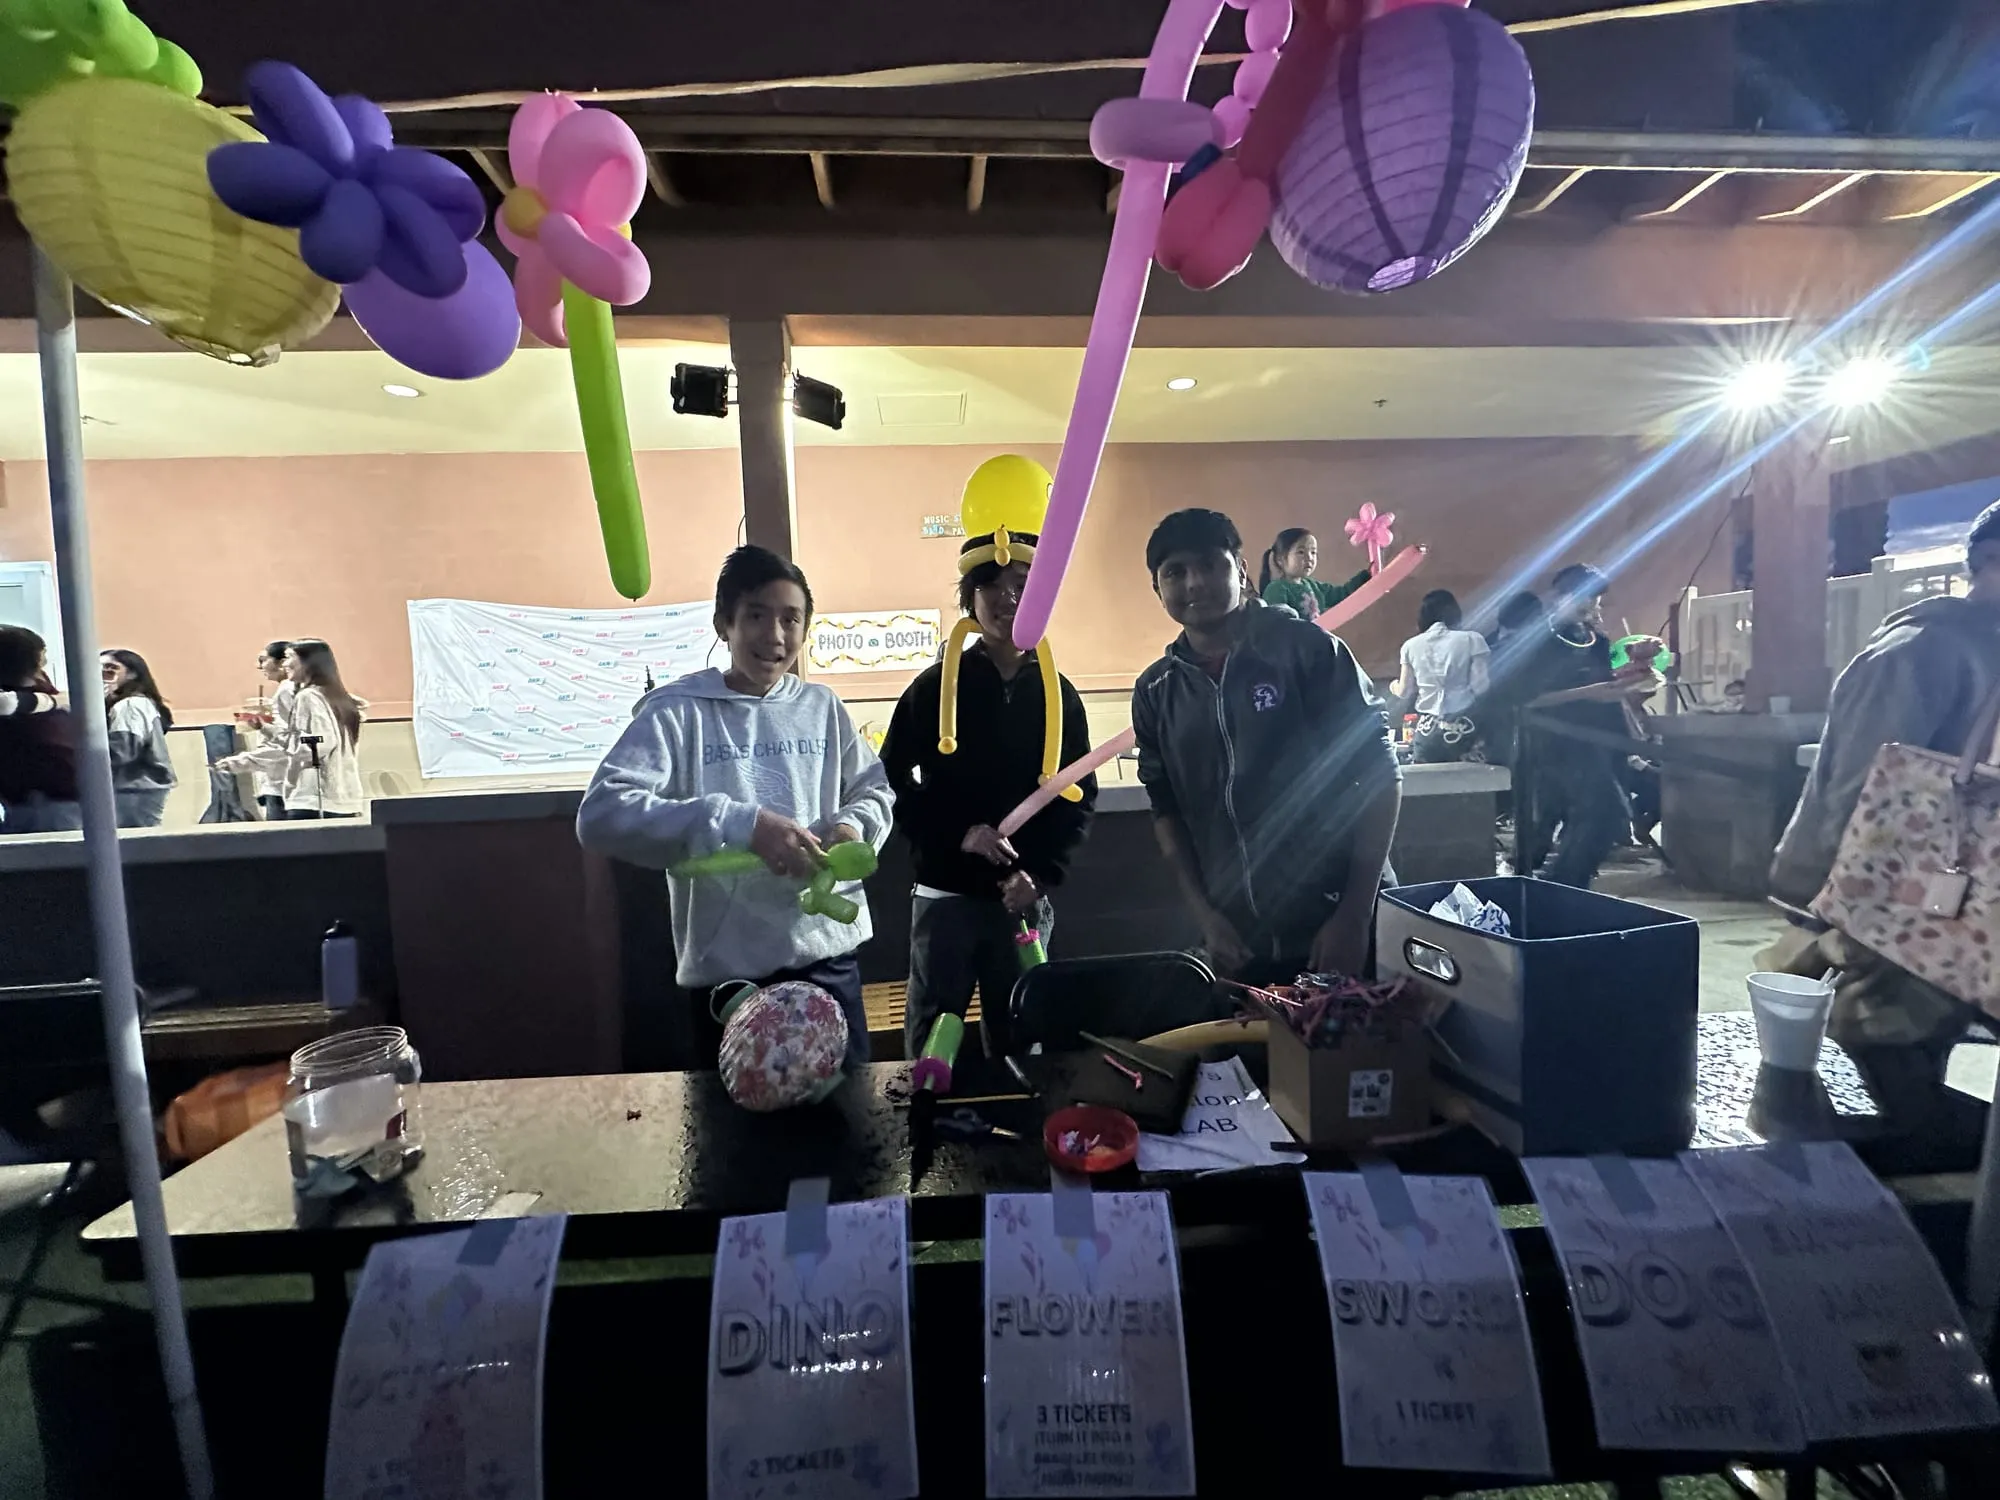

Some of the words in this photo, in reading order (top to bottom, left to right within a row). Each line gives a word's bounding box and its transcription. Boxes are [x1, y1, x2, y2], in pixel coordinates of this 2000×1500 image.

[818, 633, 864, 650] PHOTO
[885, 631, 932, 649] BOOTH
[704, 743, 750, 766] BASIS
[1564, 1250, 1769, 1335] DOG
[990, 1293, 1178, 1337] FLOWER
[717, 1289, 897, 1377] DINO
[1037, 1404, 1048, 1424] 3
[1053, 1403, 1131, 1424] TICKETS
